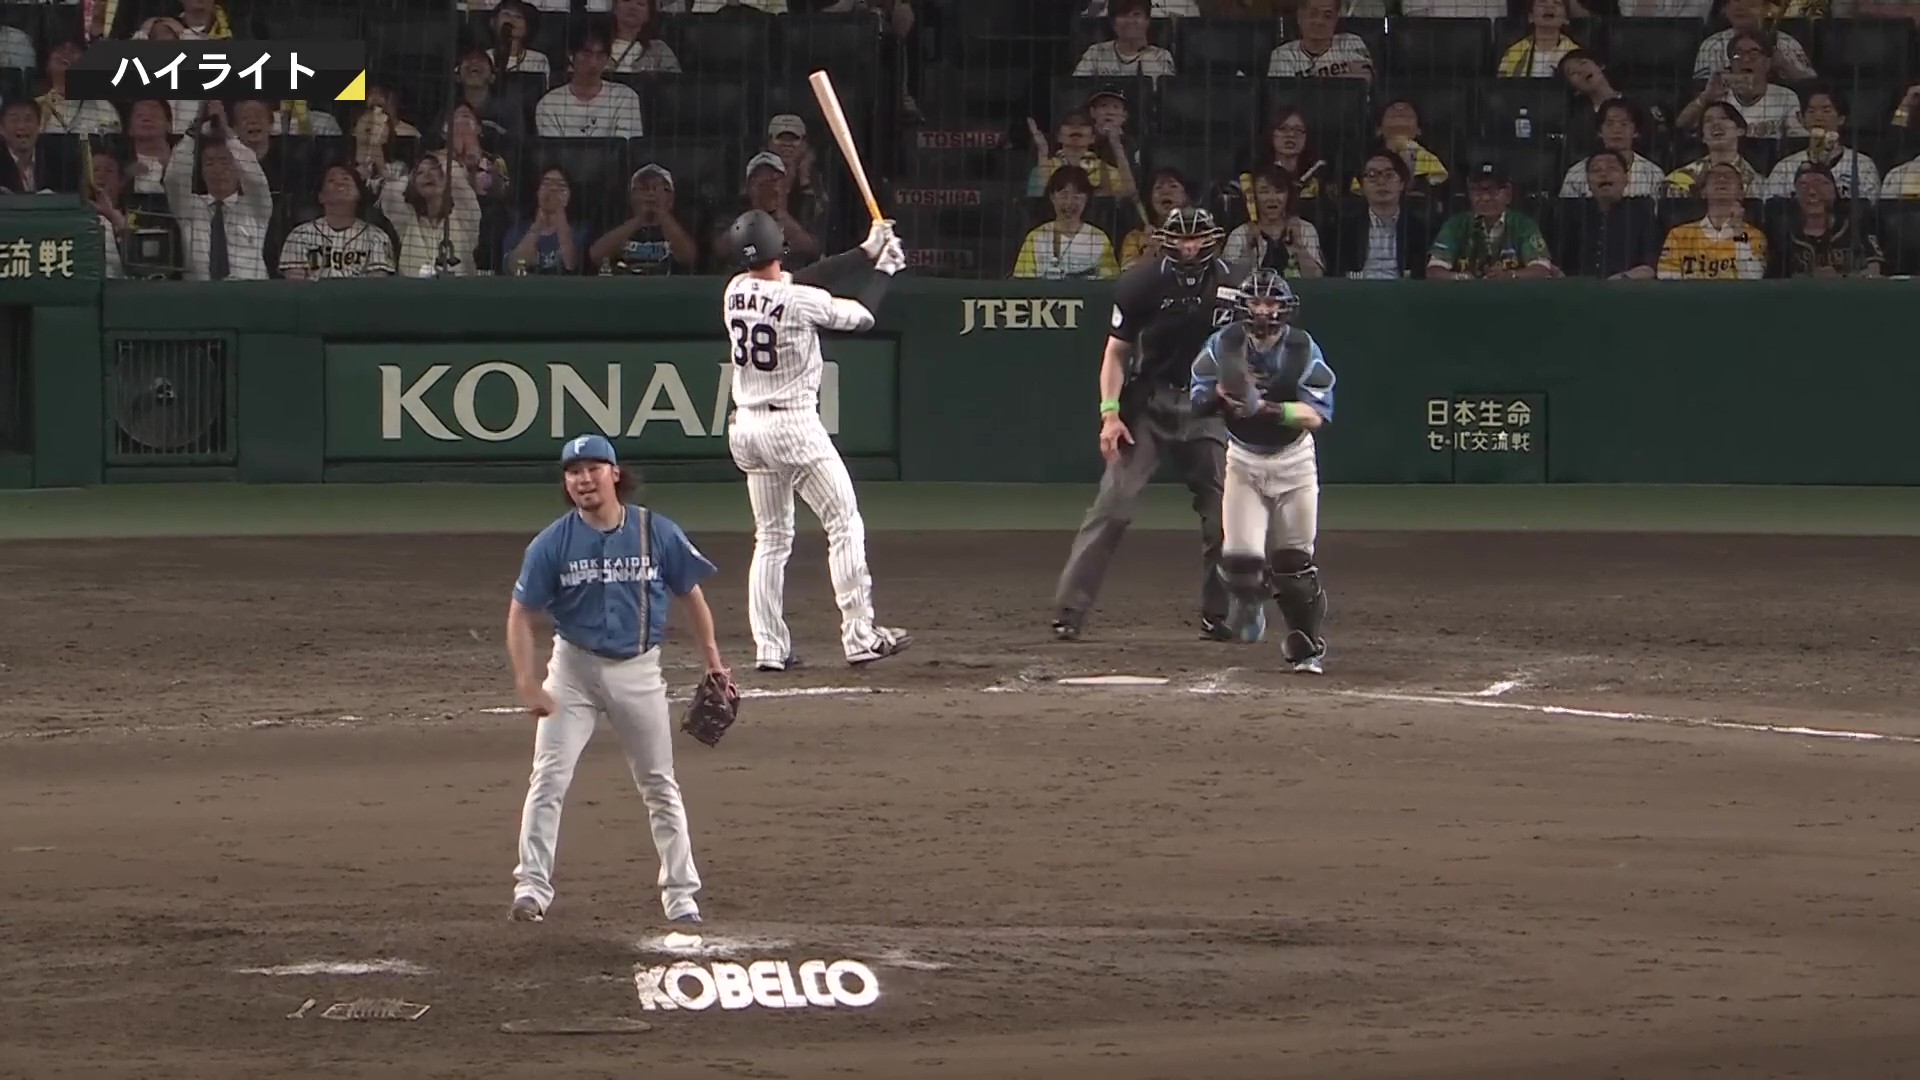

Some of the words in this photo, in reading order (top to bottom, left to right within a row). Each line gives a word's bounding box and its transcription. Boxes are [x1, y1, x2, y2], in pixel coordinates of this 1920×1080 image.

[922, 132, 1008, 147] TOSHIBA
[898, 190, 978, 204] TOSHIBA
[305, 245, 367, 271] Tiger
[728, 293, 785, 322] OBATA
[960, 298, 1084, 335] JTEKT
[731, 318, 778, 371] 38
[1428, 400, 1531, 426] 日本生命
[574, 437, 590, 454] F
[569, 556, 650, 572] HOKKAIDO
[633, 960, 880, 1011] KOBELCO
